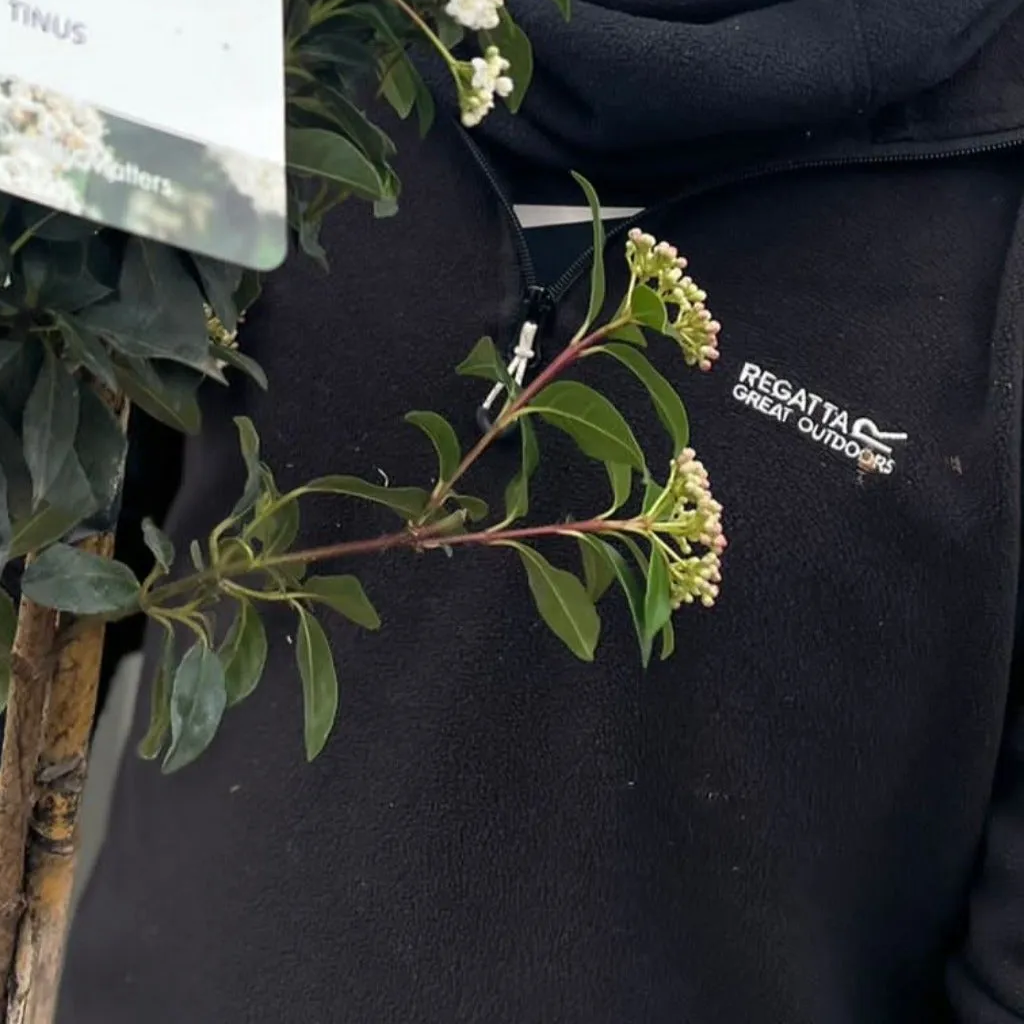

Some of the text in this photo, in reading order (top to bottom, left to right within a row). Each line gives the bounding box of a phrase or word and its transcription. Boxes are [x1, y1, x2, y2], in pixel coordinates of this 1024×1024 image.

[732, 384, 896, 475] GREAT OUTDOORS
[739, 362, 849, 434] REGATTA
